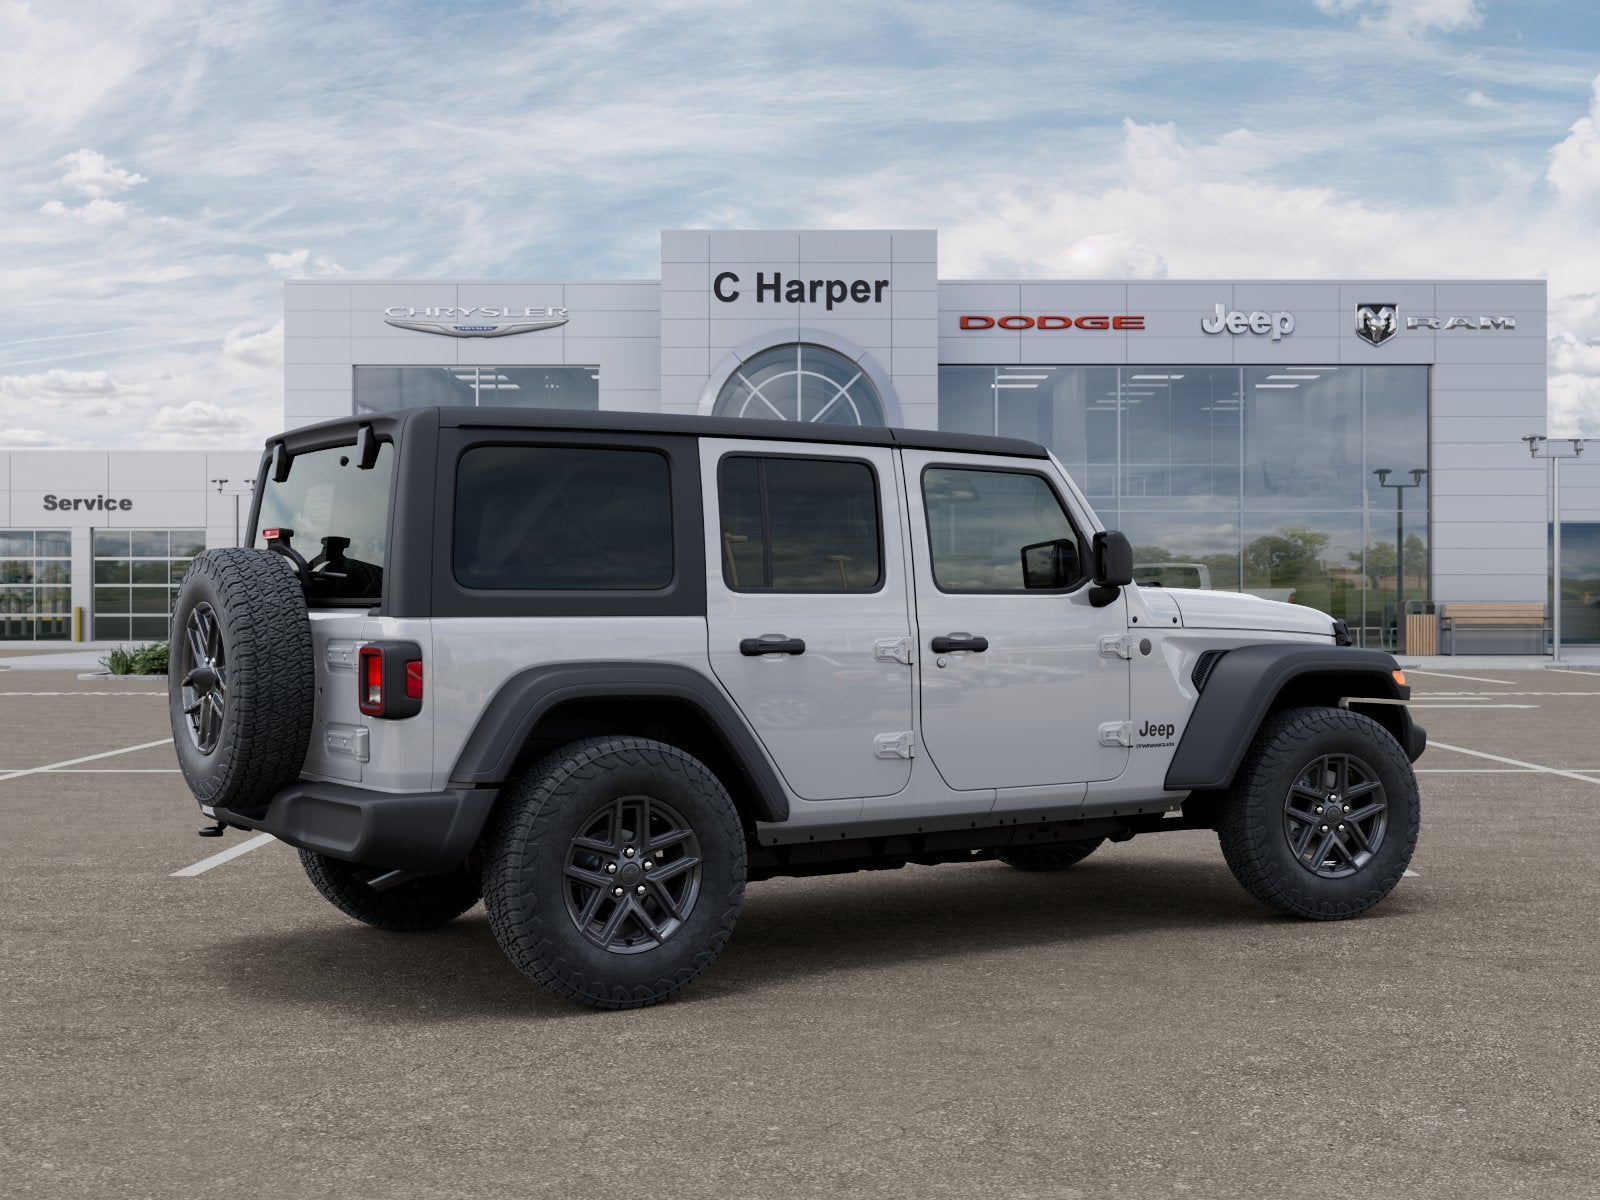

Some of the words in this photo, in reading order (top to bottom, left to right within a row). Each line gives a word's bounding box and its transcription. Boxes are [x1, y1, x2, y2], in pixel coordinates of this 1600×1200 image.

[713, 271, 740, 303] C
[757, 271, 890, 310] Harper
[385, 306, 569, 318] CHRYSLER
[959, 315, 1146, 330] DODGE
[1201, 303, 1296, 341] Jeep
[1406, 316, 1516, 330] RAM
[43, 494, 133, 511] Service
[1138, 720, 1175, 740] Jeep
